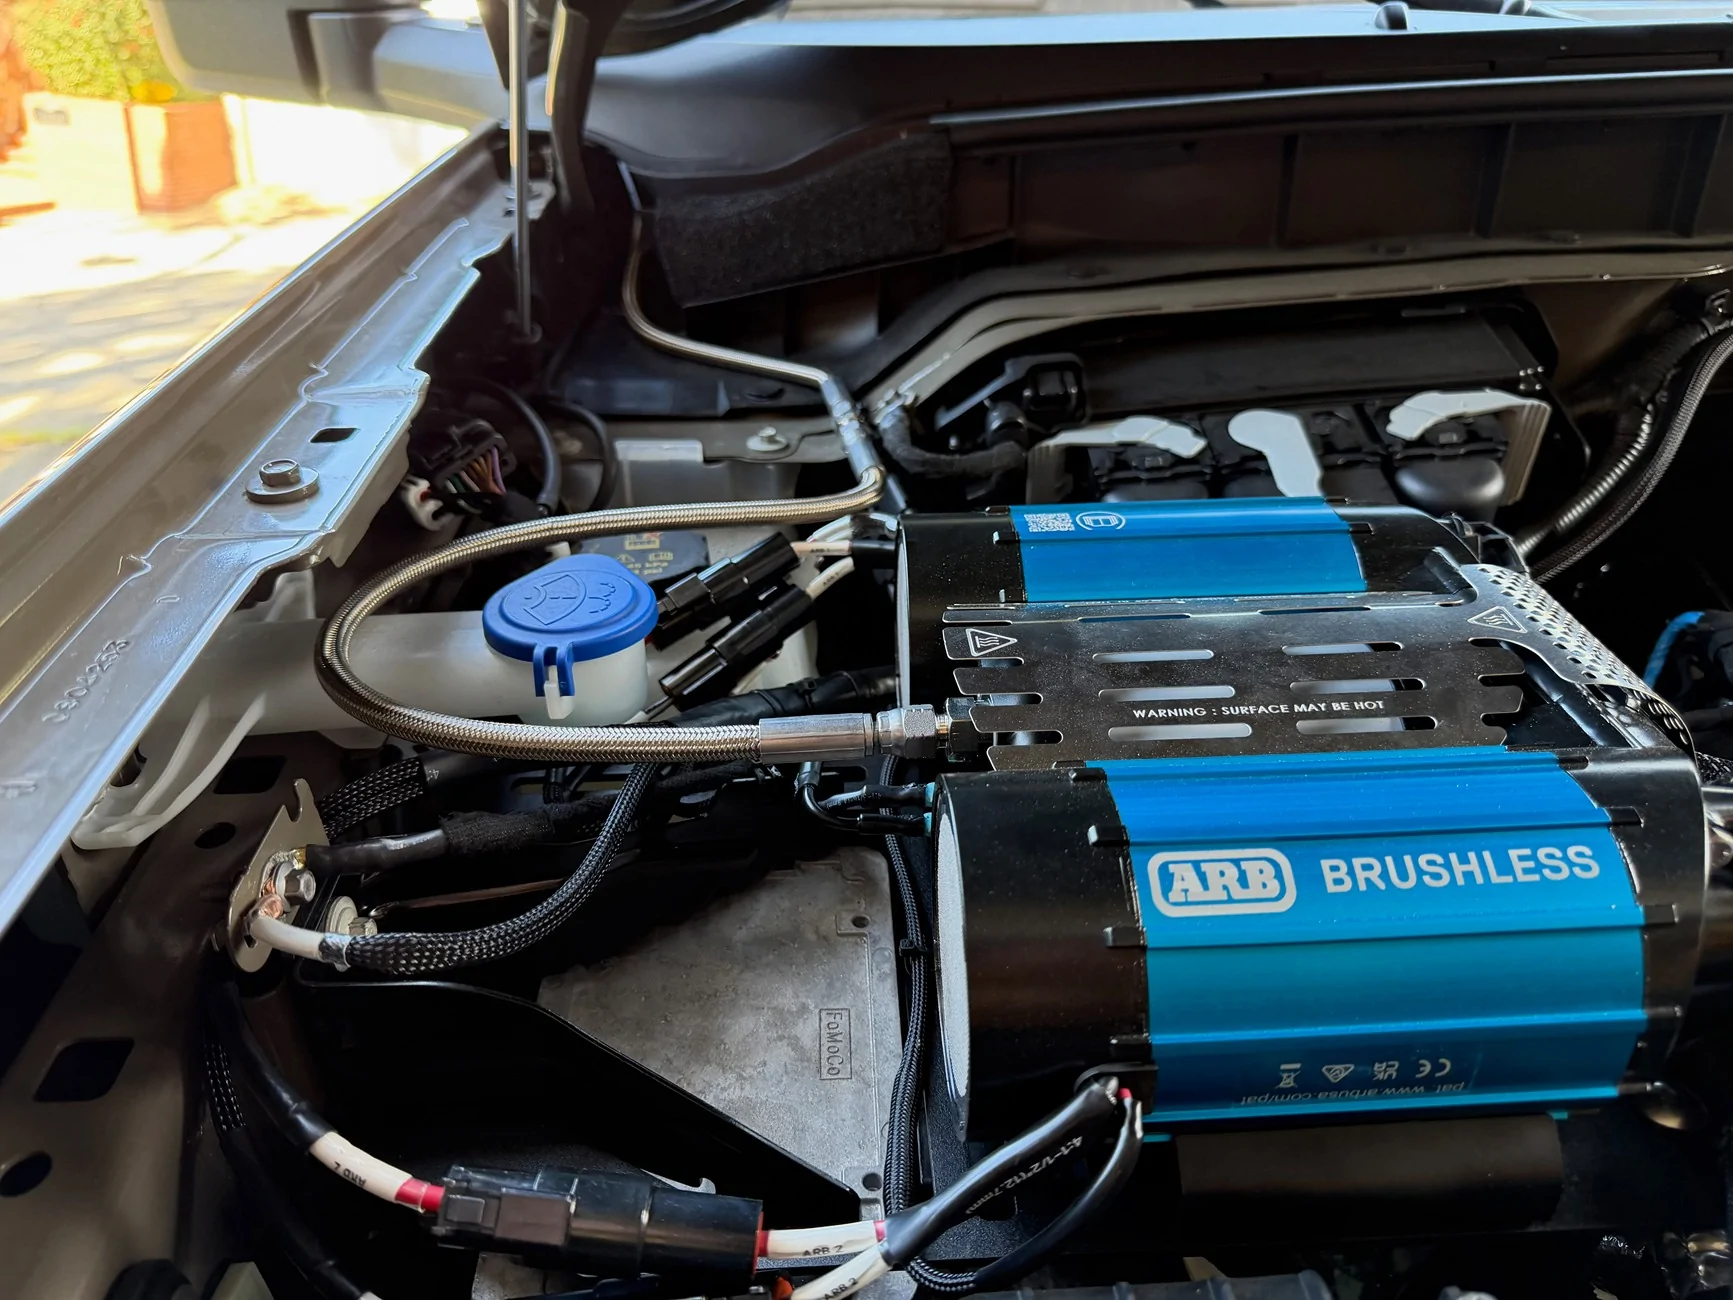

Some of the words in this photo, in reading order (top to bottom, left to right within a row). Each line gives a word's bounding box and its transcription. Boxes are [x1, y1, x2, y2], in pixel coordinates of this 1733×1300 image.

[1133, 707, 1207, 719] WARNING
[1221, 704, 1290, 715] SURFACE
[1294, 702, 1327, 713] MAY
[1331, 702, 1351, 712] BE
[1354, 700, 1385, 710] HOT
[1168, 860, 1281, 902] ARB
[1320, 845, 1600, 893] BRUSHLESS
